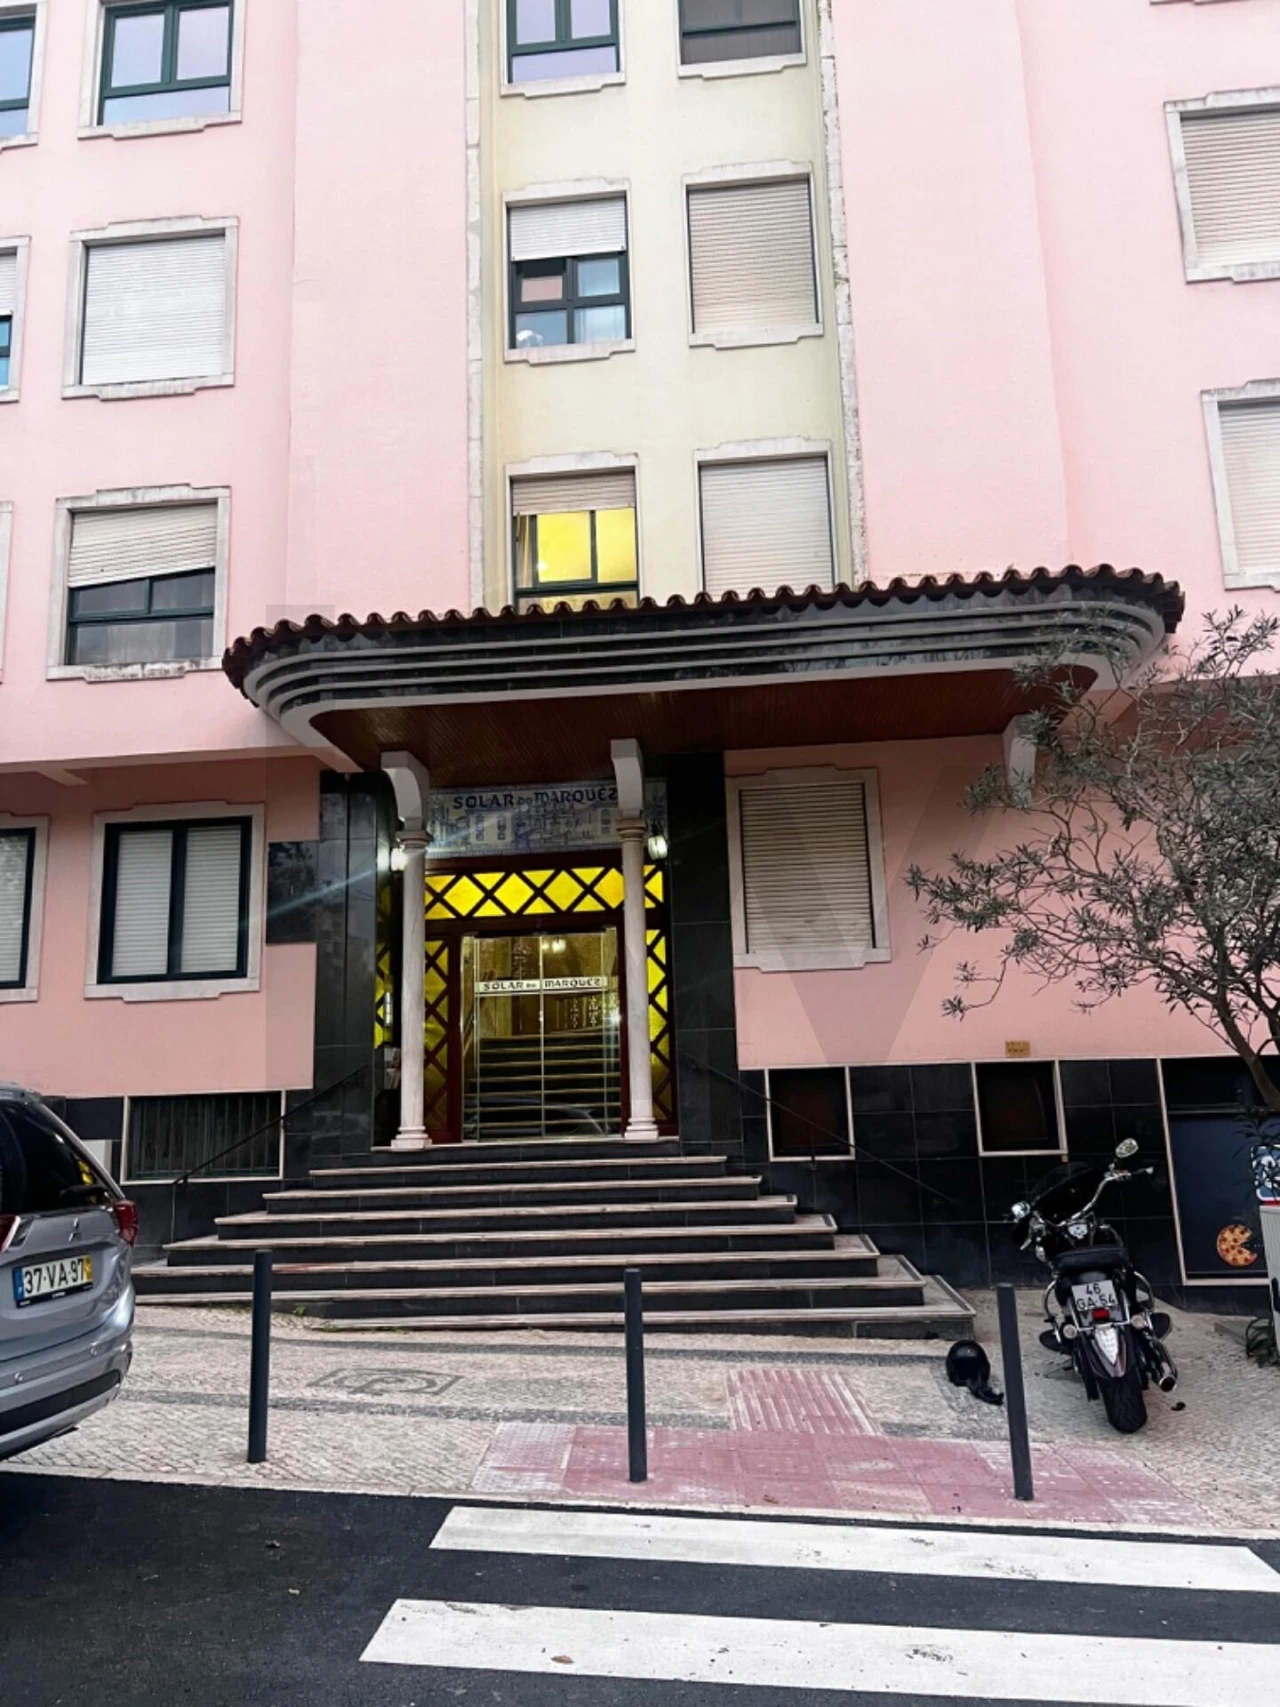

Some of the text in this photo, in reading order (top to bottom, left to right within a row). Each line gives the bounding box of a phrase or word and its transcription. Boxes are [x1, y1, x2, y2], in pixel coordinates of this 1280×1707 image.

[452, 792, 515, 810] SOLAR
[483, 981, 524, 992] SOLAR
[1086, 1282, 1101, 1295] 46
